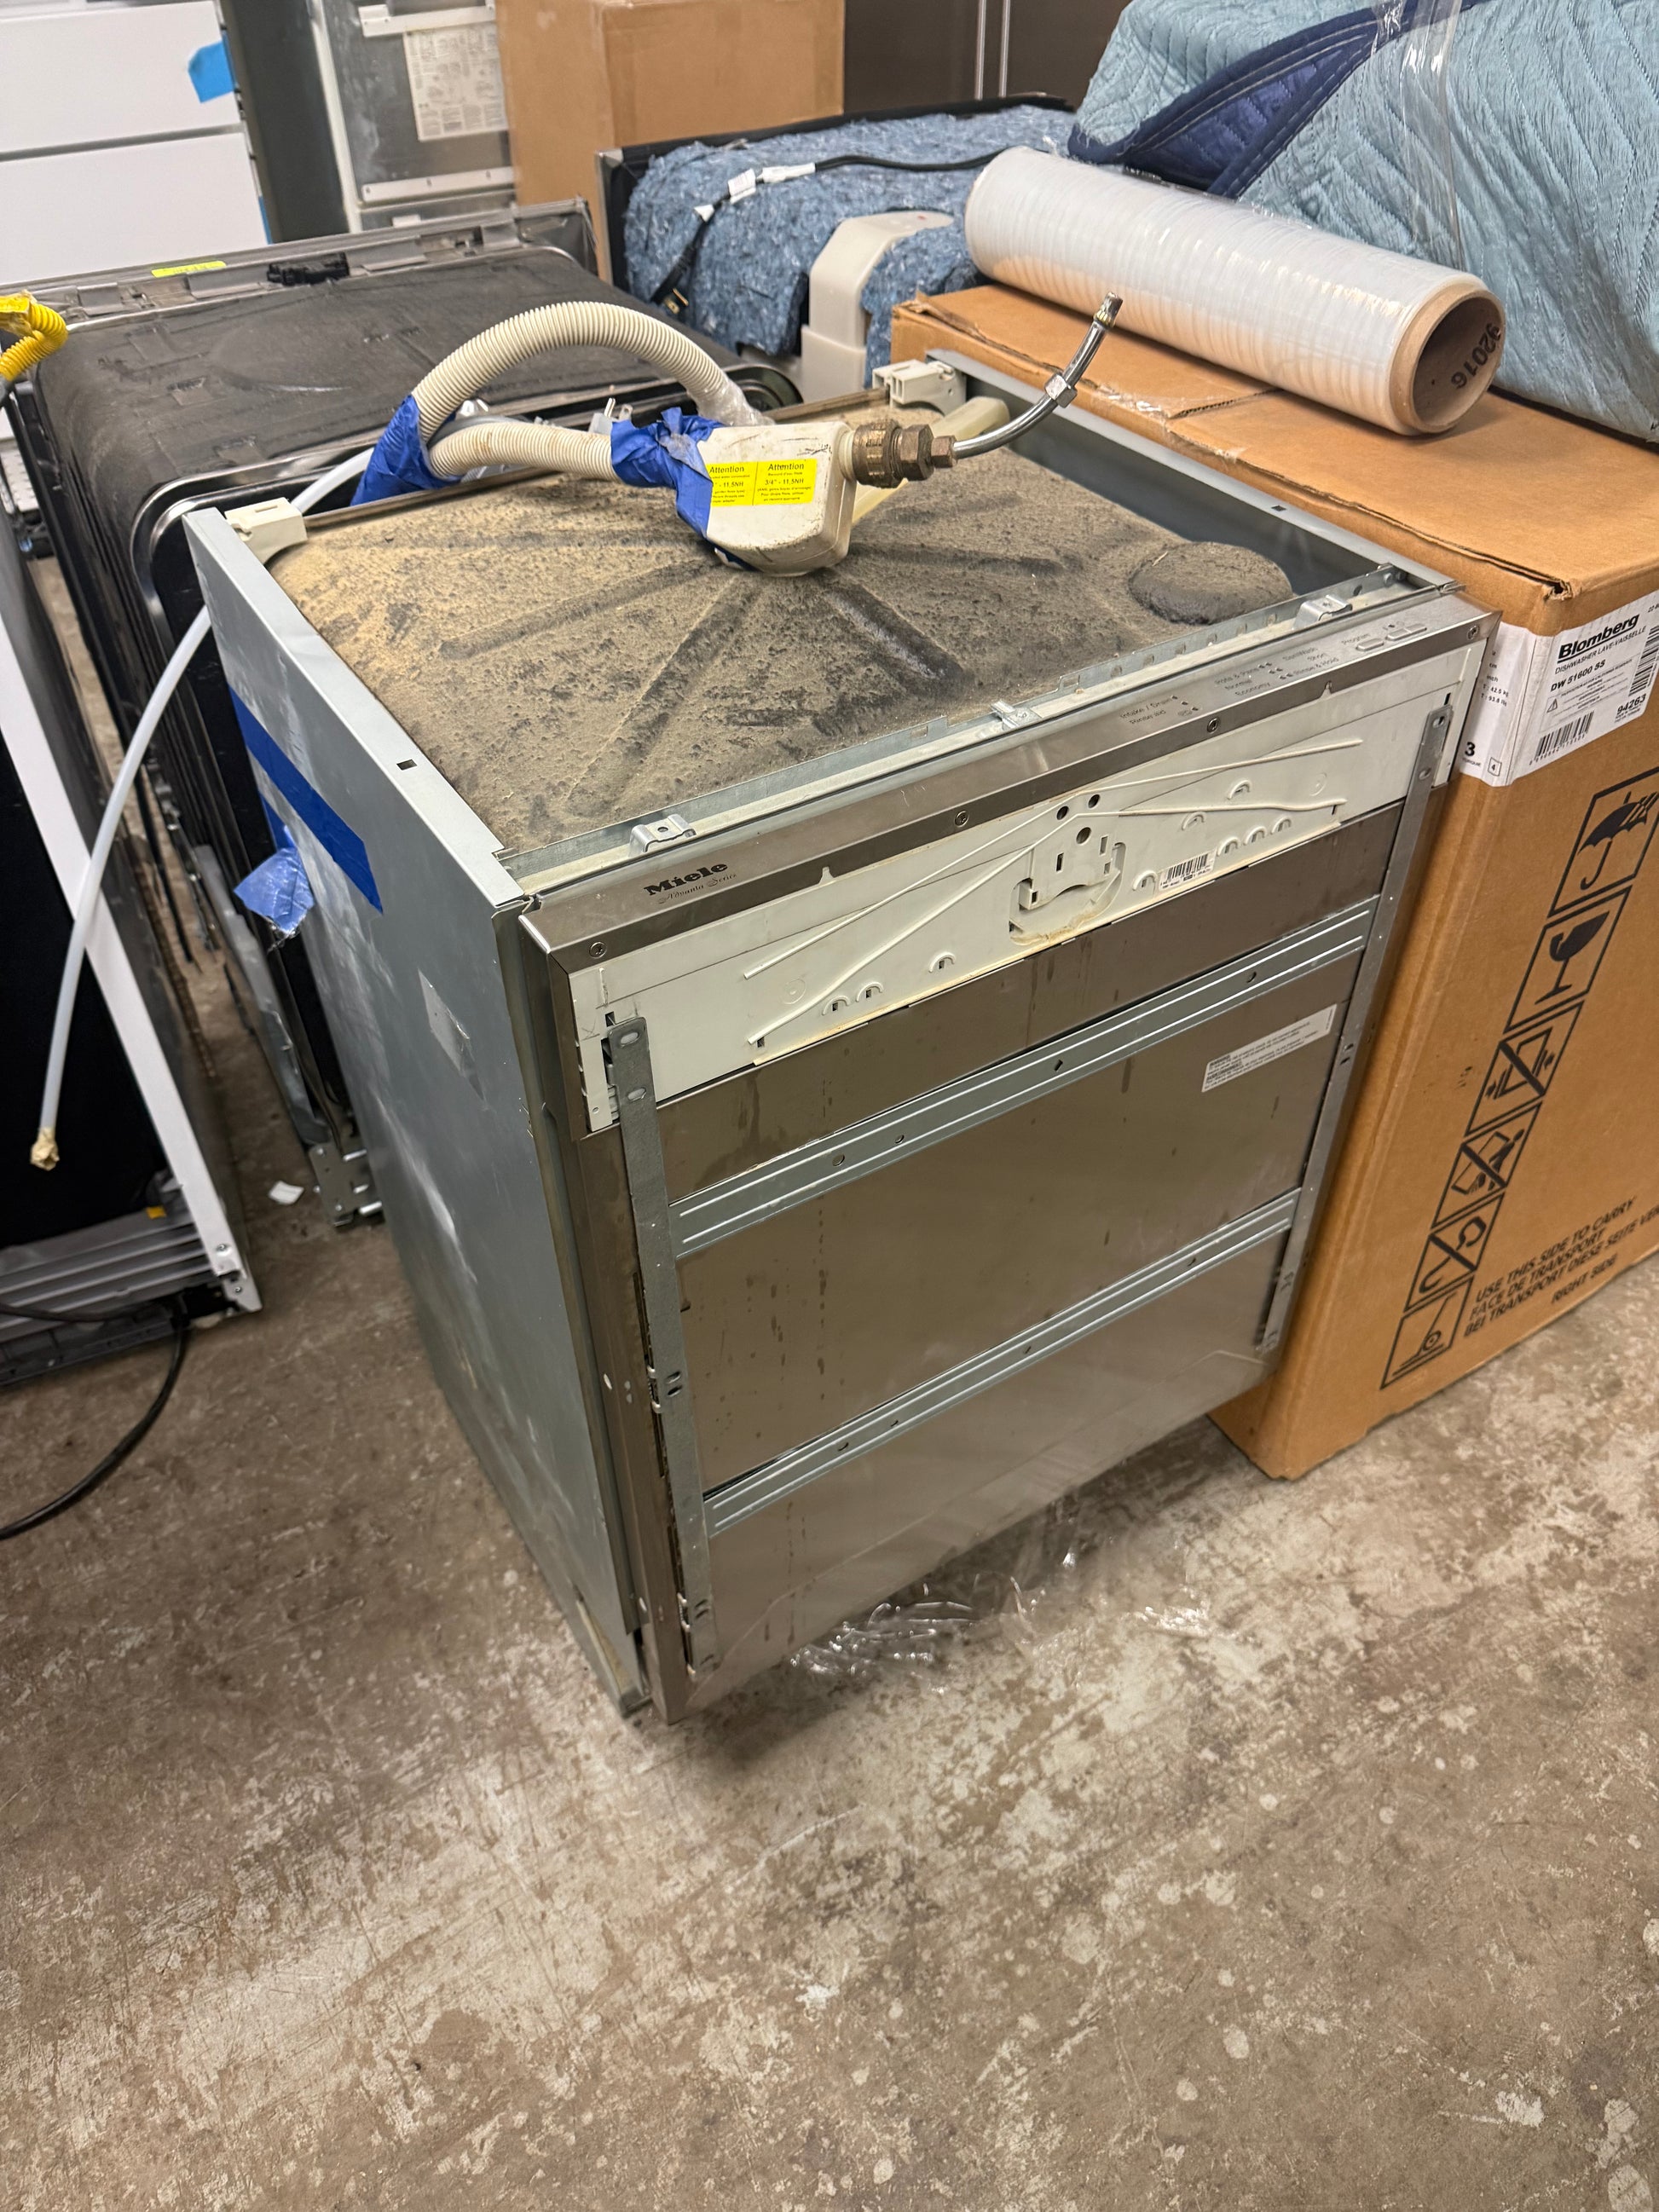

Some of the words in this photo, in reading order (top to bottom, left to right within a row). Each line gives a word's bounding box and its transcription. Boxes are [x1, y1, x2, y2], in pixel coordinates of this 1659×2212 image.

[709, 465, 744, 474] Attention
[768, 463, 805, 471] Attention
[1558, 614, 1640, 660] Blomberg
[1550, 679, 1567, 692] DW
[1593, 659, 1606, 671] SS
[1554, 650, 1598, 675] DISHWASHER
[1465, 742, 1476, 757] 3
[644, 863, 729, 896] Miele
[1476, 1277, 1504, 1303] USE
[1507, 1256, 1536, 1284] THIS
[1537, 1235, 1569, 1266] SIDE
[1572, 1224, 1590, 1244] TO
[1592, 1195, 1638, 1231] CARRY
[1463, 1314, 1487, 1337] BEI
[1489, 1266, 1567, 1321] TRANSPORT
[1566, 1240, 1604, 1273] DIESE
[1604, 1218, 1639, 1250] SEITE
[1470, 1289, 1504, 1321] FACE
[1506, 1278, 1528, 1297] DE
[1529, 1226, 1607, 1283] TRANSPORT
[1551, 1271, 1589, 1304] RIGHT
